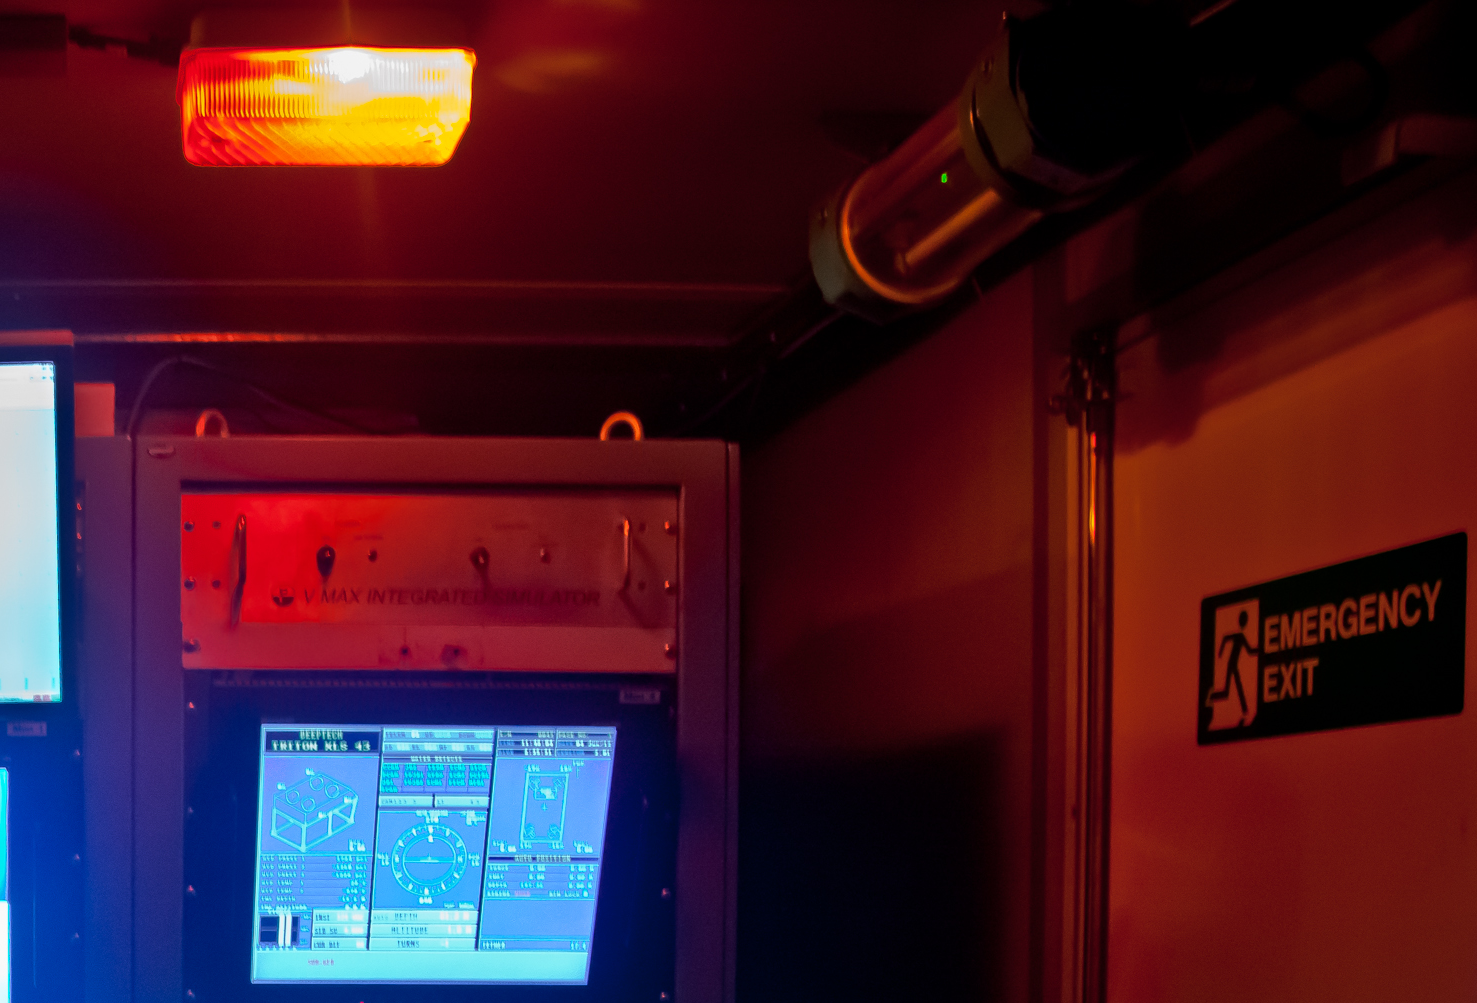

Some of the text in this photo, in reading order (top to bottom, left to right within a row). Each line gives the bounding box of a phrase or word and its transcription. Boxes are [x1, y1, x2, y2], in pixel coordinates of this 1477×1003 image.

[367, 588, 487, 606] INTEGRATED
[490, 588, 601, 607] SIMULATOR
[1264, 578, 1443, 654] EMERGENCY
[1263, 656, 1320, 704] EXIT
[299, 729, 343, 740] DEEPTECH
[271, 740, 318, 751] TRITON
[390, 925, 429, 935] ALTITUDE
[396, 940, 420, 949] TURNS
